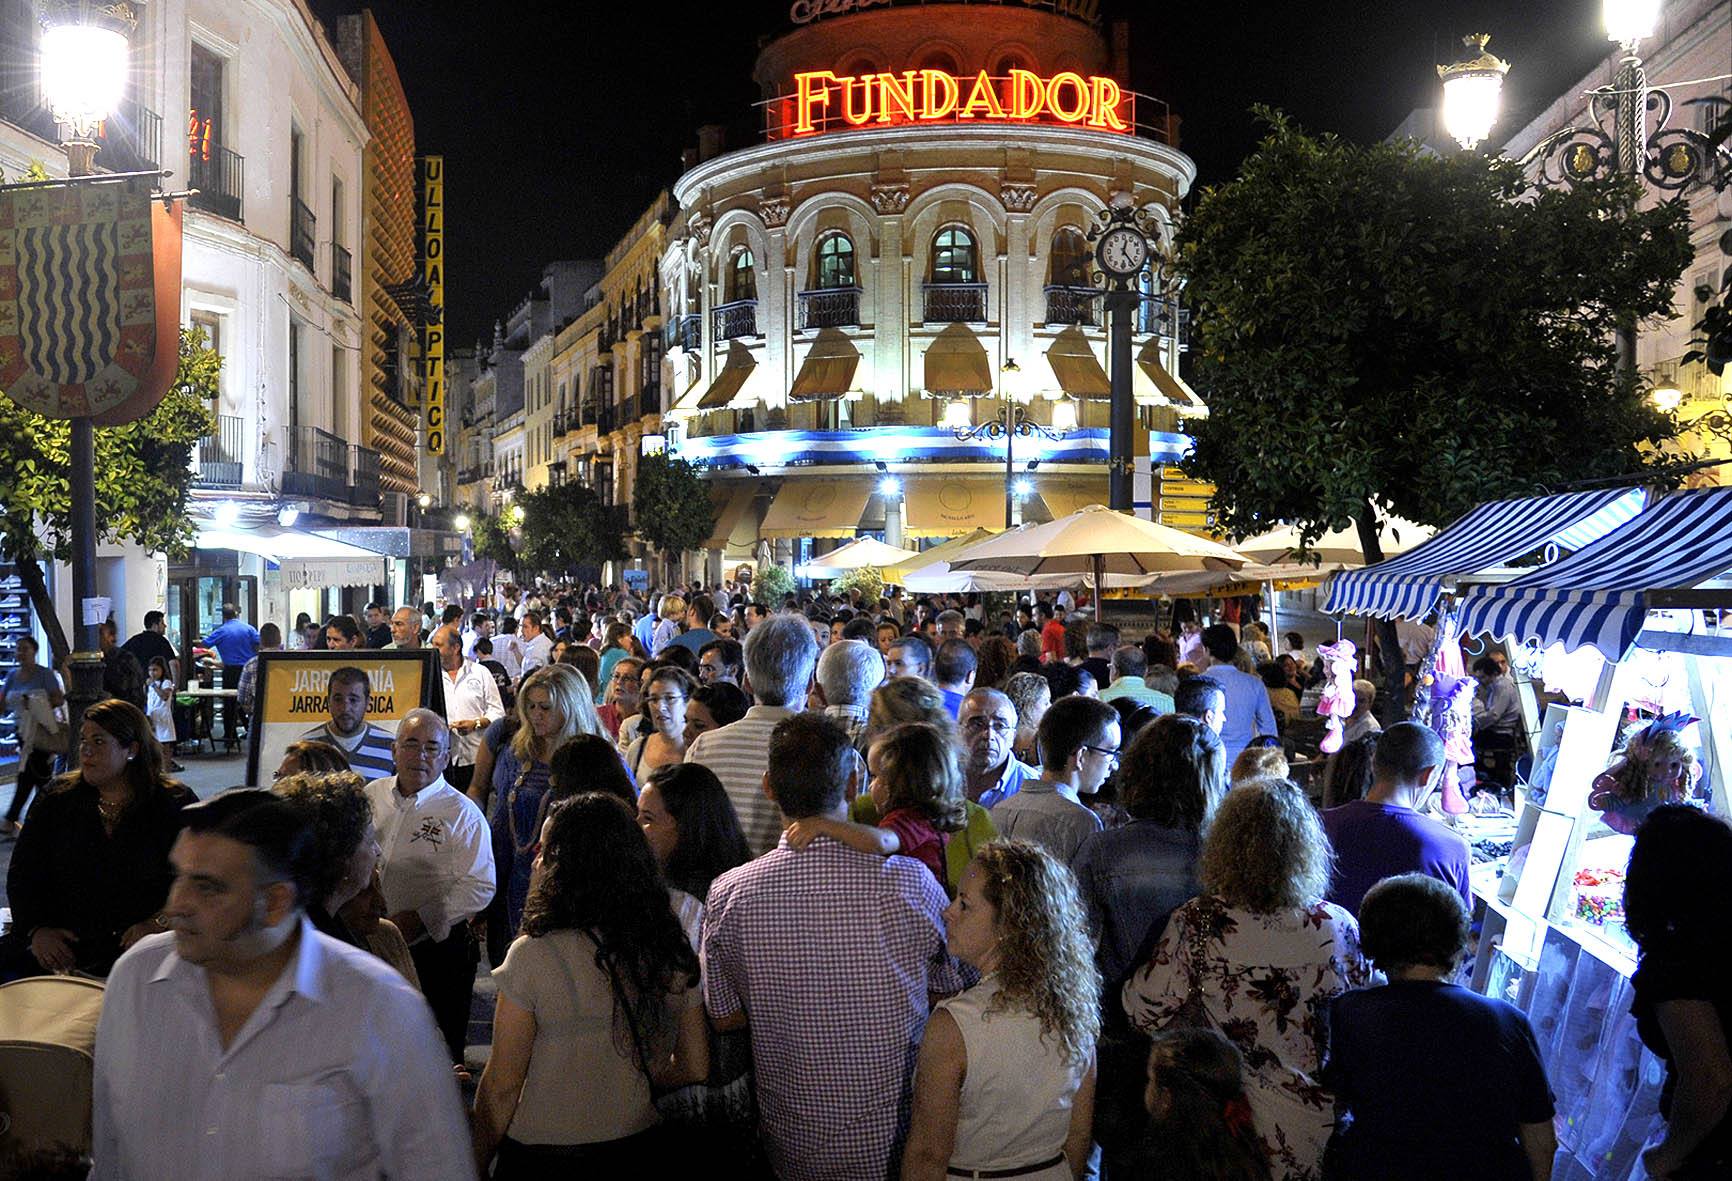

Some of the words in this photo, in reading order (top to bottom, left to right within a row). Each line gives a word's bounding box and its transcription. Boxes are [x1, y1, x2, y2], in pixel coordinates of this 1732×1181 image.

[793, 68, 1128, 134] FUNDADOR
[426, 160, 441, 285] ULLOA
[288, 695, 330, 713] JARRA
